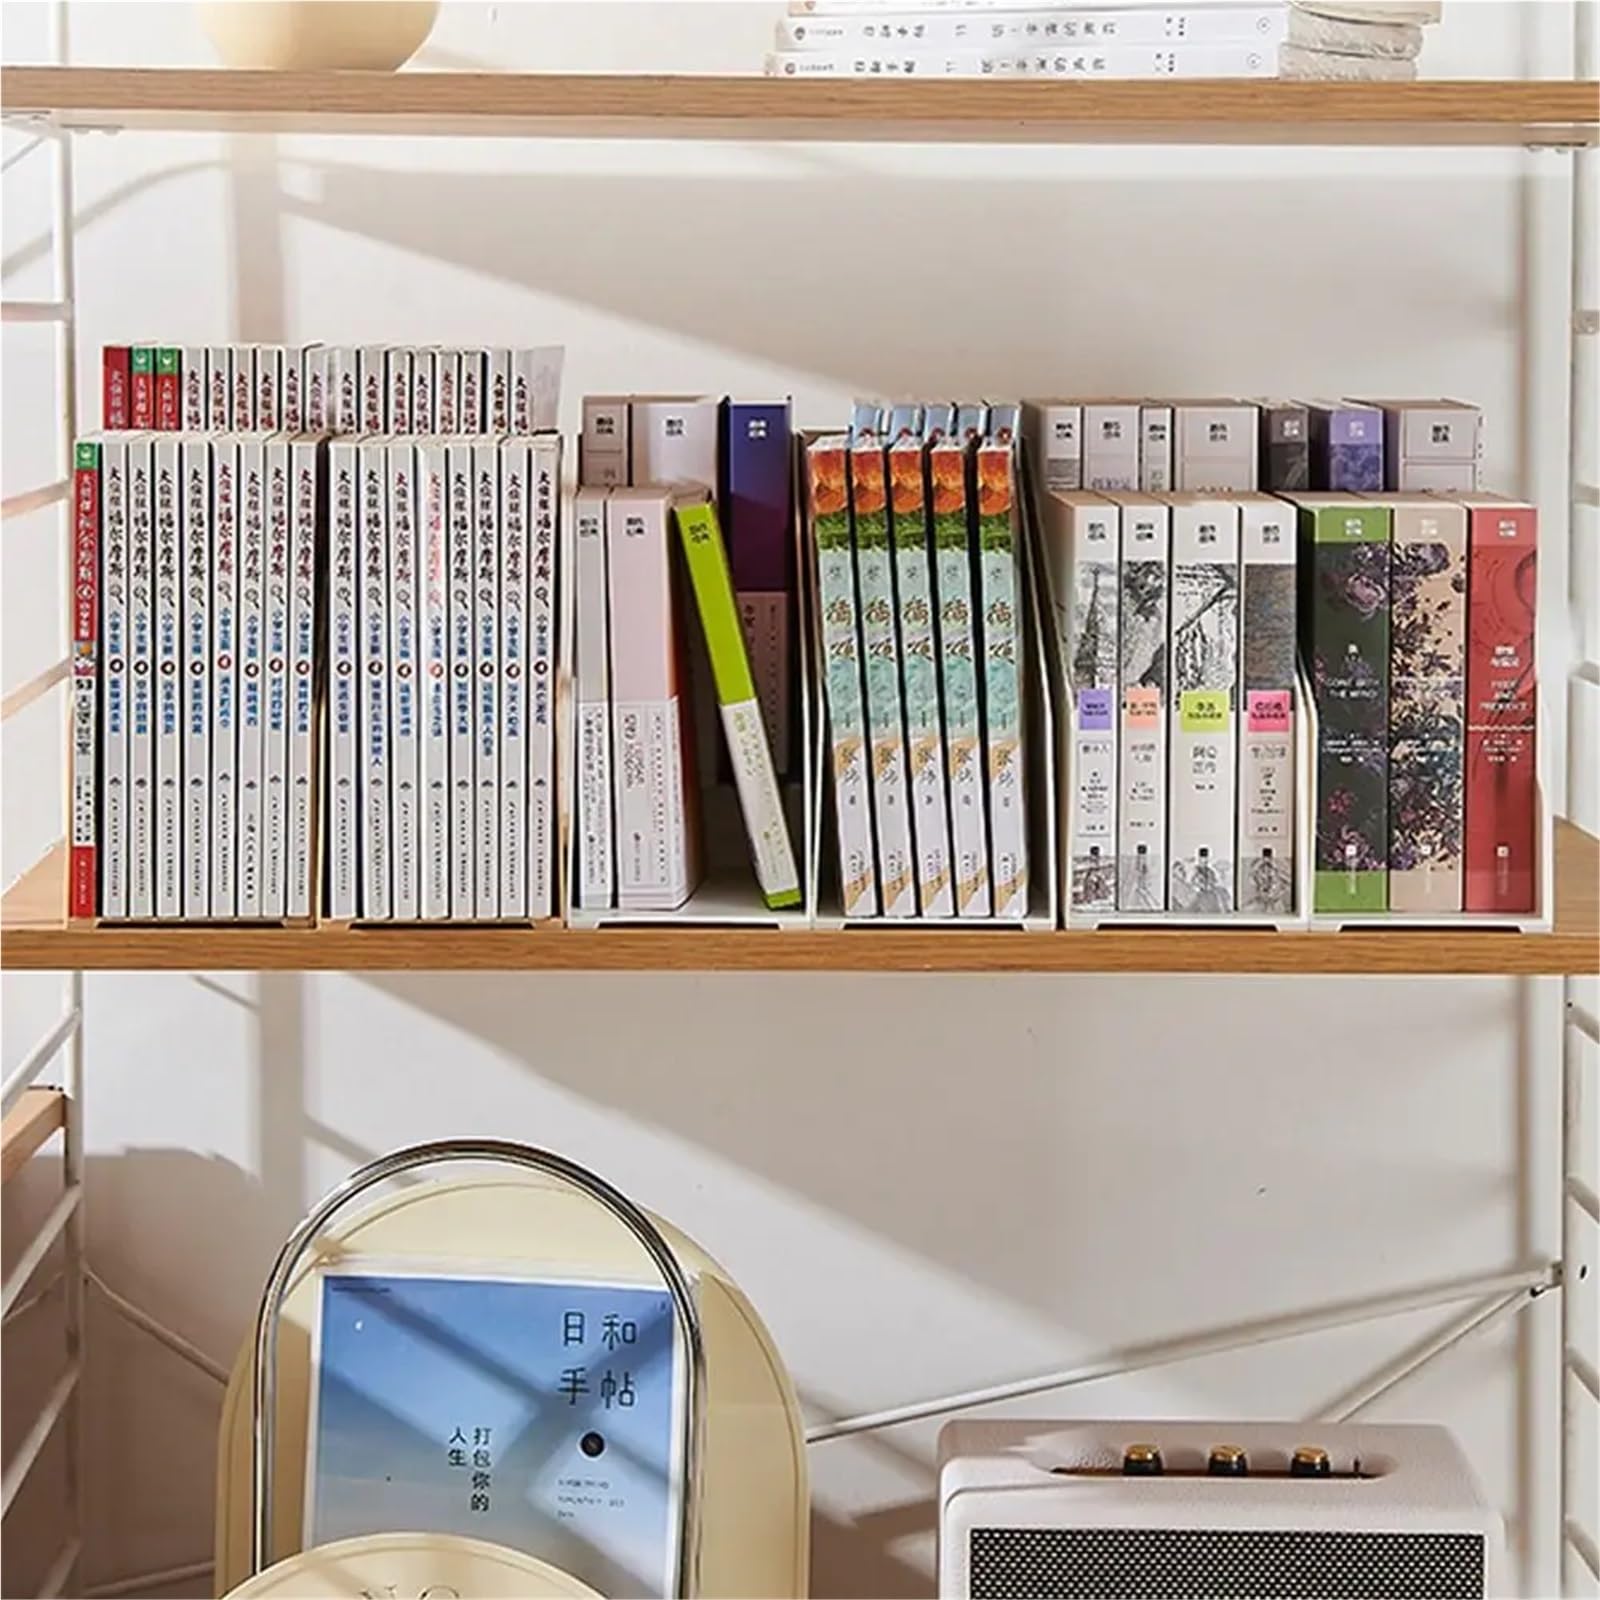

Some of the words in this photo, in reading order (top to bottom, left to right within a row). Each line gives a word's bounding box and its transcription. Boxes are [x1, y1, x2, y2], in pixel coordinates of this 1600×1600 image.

[563, 1311, 637, 1351] 日和
[557, 1367, 635, 1409] 手帖
[447, 1427, 469, 1467] 人生
[470, 1427, 492, 1512] 打包你的
